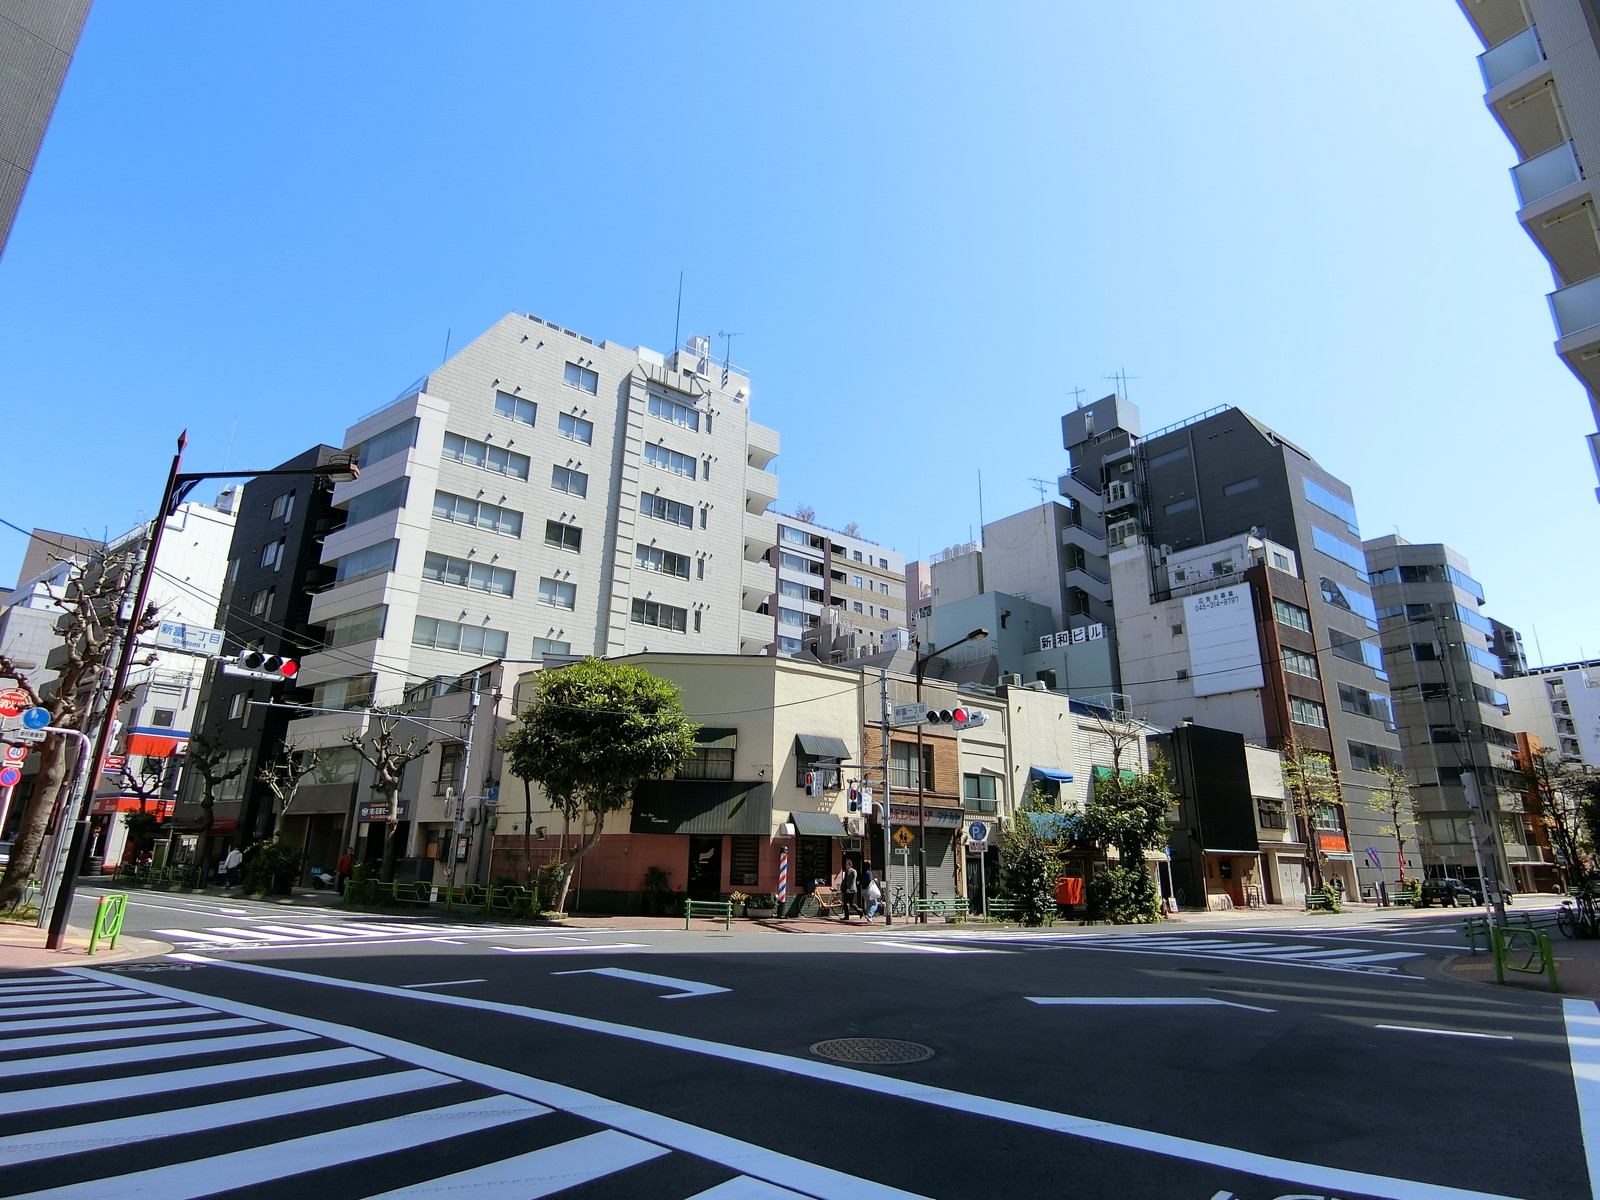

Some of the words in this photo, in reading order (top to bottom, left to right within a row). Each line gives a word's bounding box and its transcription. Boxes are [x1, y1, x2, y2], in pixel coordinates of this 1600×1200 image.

[1194, 596, 1239, 611] 045-314-9797
[161, 623, 221, 644] 新富一丁目
[1041, 626, 1101, 649] 新和ビル
[172, 637, 200, 648] Shintomi
[895, 704, 925, 716] 新富一丁目
[10, 746, 22, 757] 40
[972, 826, 980, 839] P
